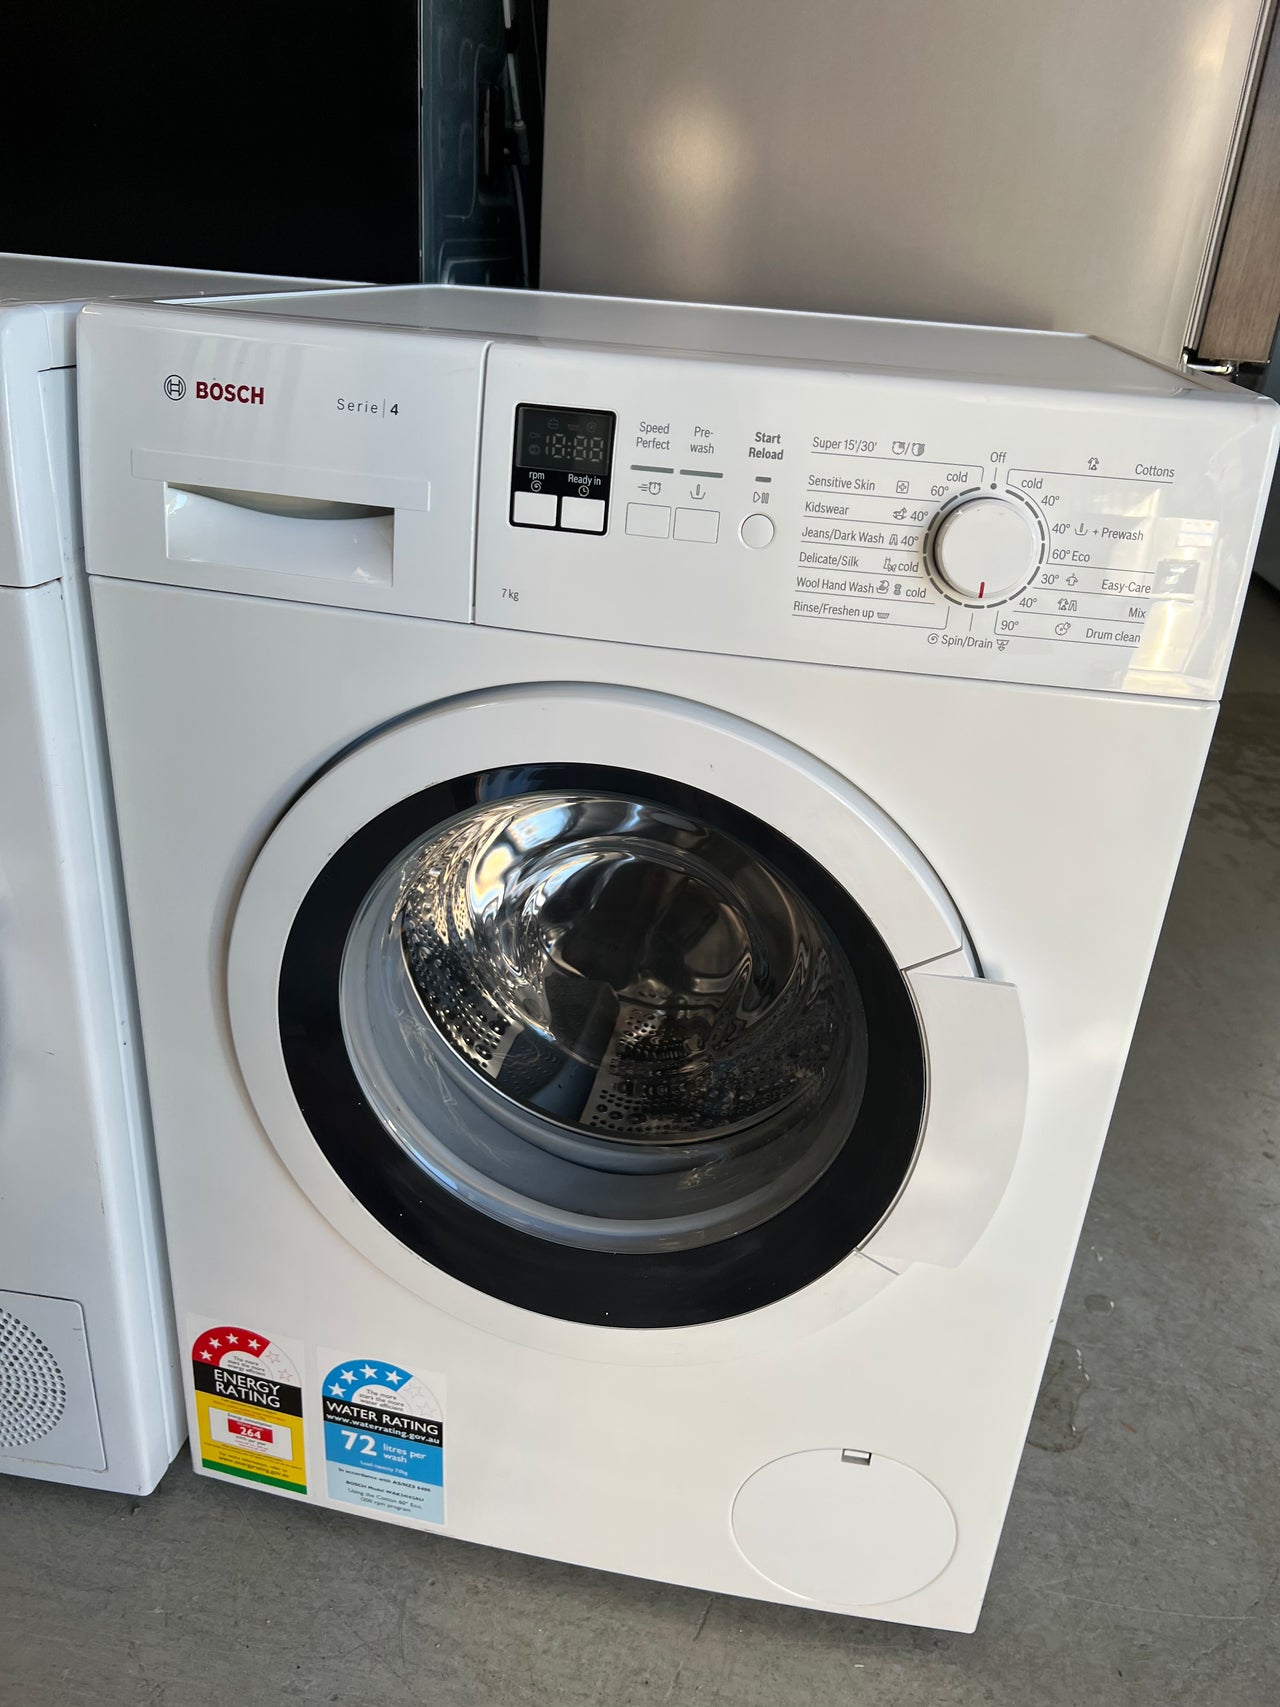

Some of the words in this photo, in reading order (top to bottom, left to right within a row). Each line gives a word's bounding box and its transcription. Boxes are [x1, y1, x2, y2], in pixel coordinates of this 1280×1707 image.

[196, 381, 265, 405] BOSCH
[337, 398, 378, 414] Serie
[390, 403, 399, 416] 4
[639, 421, 670, 435] Speed
[694, 426, 714, 438] Pre-
[636, 437, 670, 450] Perfect
[755, 432, 781, 444] Start
[813, 436, 842, 451] Super
[690, 443, 714, 454] wash
[748, 447, 784, 460] Reload
[990, 451, 1007, 463] Off
[529, 471, 545, 481] rpm
[946, 471, 968, 483] cold
[1135, 464, 1175, 478] Cottons
[568, 474, 593, 486] Ready
[594, 476, 602, 486] in
[808, 475, 852, 489] Sensitive
[854, 479, 876, 491] Skin
[1021, 478, 1043, 490] cold
[805, 501, 849, 515] Kidswear
[802, 527, 857, 542] Jeans/Dark
[858, 531, 885, 544] Wash
[1101, 528, 1144, 542] Prewash
[799, 552, 859, 567] Delicate/Silk
[898, 561, 919, 572] cold
[1072, 551, 1090, 562] Eco
[796, 576, 820, 589] Wool
[822, 579, 846, 591] Hand
[850, 581, 874, 594] Wash
[906, 587, 926, 598] cold
[1101, 580, 1151, 594] Easy-Care
[793, 601, 860, 617] Rinse/Freshen
[862, 609, 874, 619] up
[1128, 607, 1146, 619] Mix
[941, 634, 993, 649] Spin/Drain
[1086, 628, 1113, 641] Drum
[1114, 630, 1141, 643] clean
[214, 1369, 280, 1395] ENERGY
[216, 1381, 280, 1408] RATING
[366, 1388, 379, 1396] The
[326, 1401, 378, 1422] WATER
[382, 1414, 438, 1435] RATING
[239, 1426, 261, 1439] 264
[326, 1413, 440, 1444] www.waterrating.gov.au
[341, 1430, 377, 1456] 72
[383, 1443, 407, 1455] litres
[410, 1450, 426, 1460] per
[383, 1453, 407, 1463] wash
